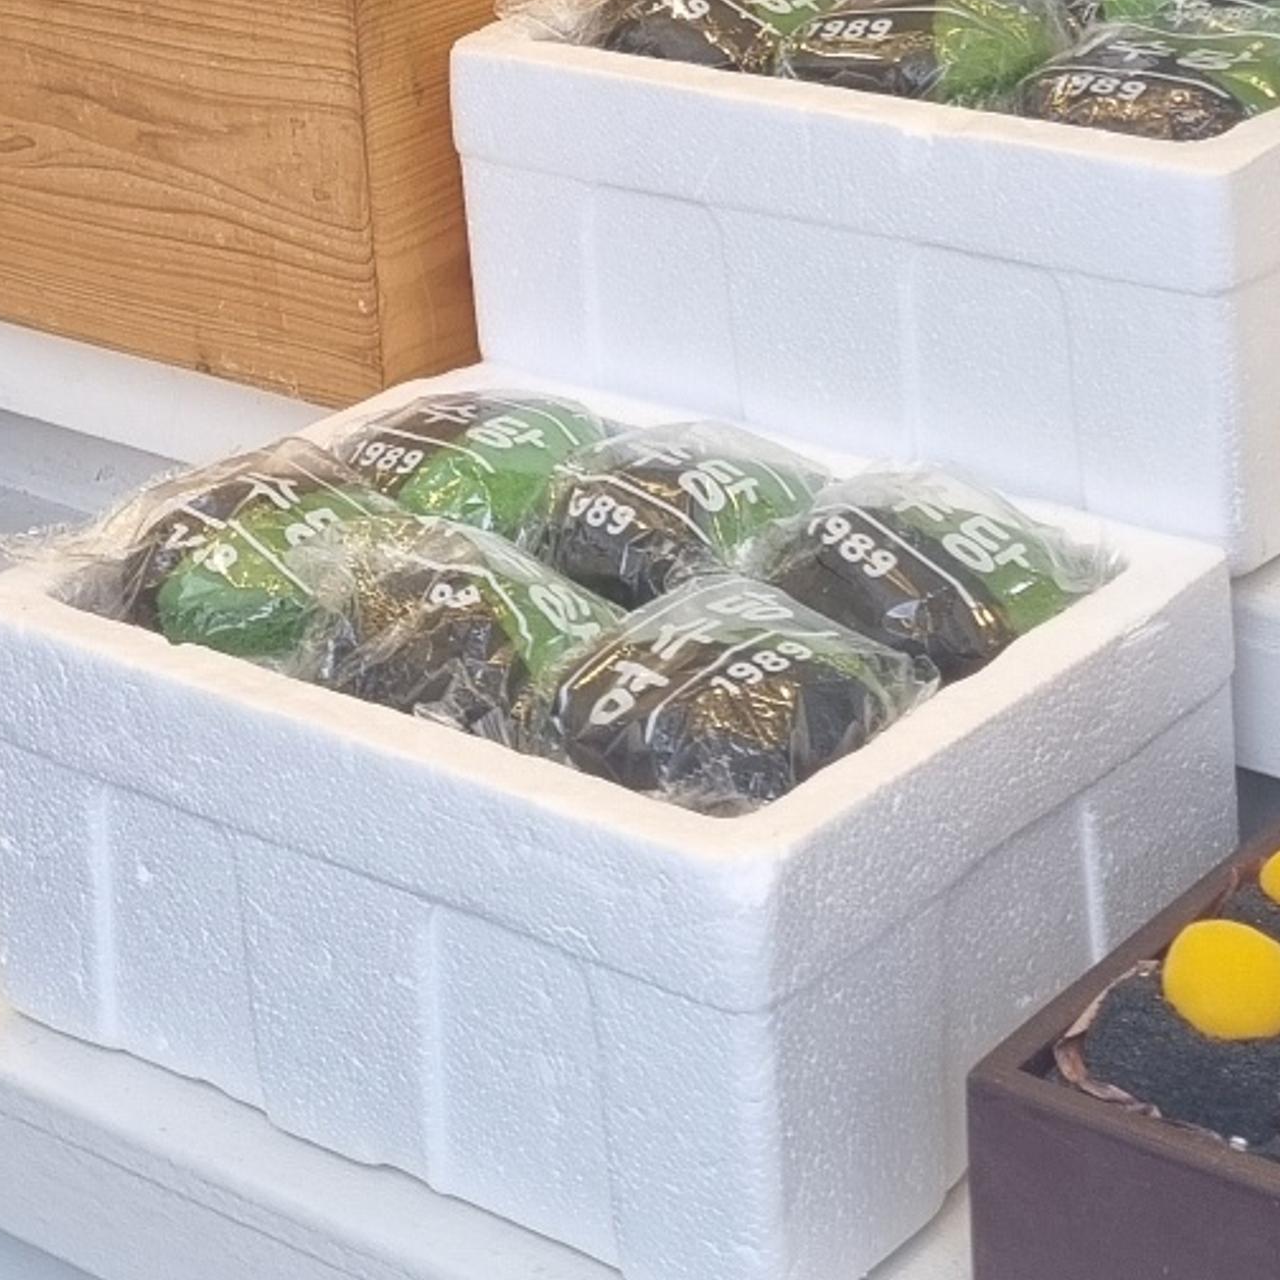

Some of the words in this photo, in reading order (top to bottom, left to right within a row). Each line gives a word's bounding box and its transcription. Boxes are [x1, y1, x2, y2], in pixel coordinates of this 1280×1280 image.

[807, 18, 893, 42] 1989
[349, 439, 425, 474] 1989
[710, 640, 813, 697] 1989
